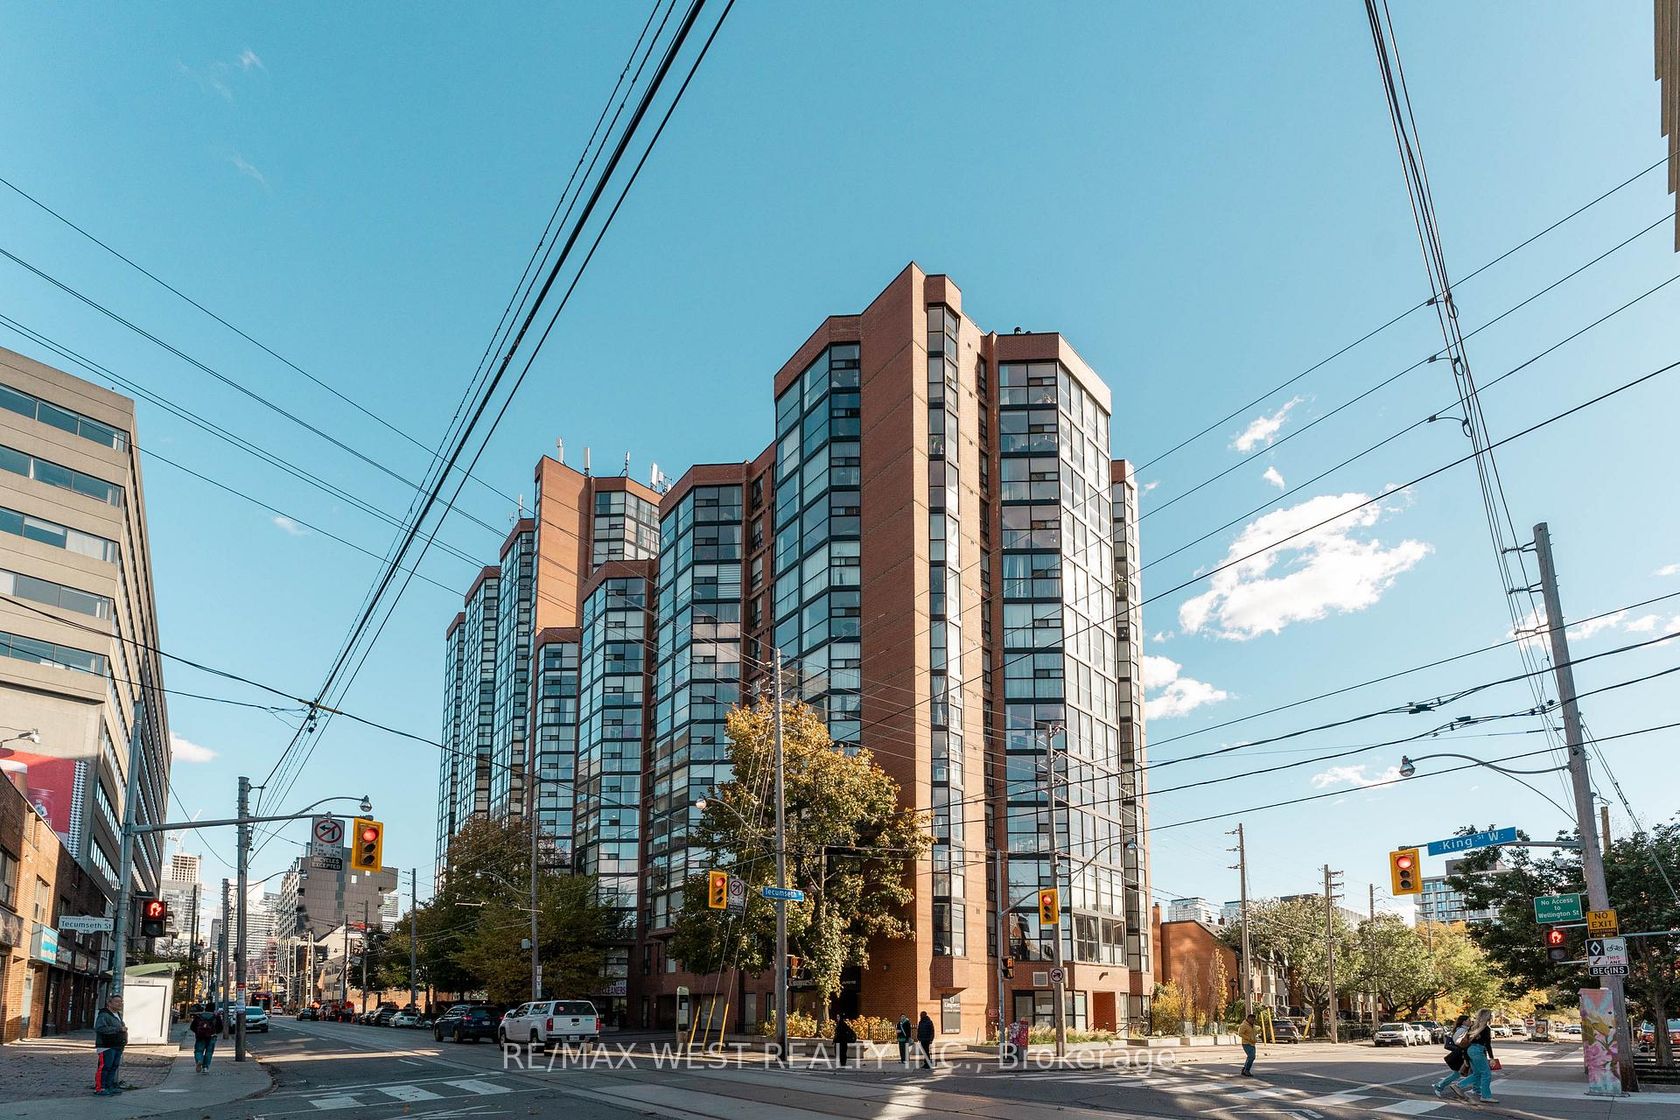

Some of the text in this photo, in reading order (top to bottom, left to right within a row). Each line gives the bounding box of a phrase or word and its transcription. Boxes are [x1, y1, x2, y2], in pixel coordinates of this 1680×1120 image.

[1442, 838, 1473, 850] King
[1488, 831, 1499, 842] W
[1538, 911, 1571, 919] Wellington
[61, 920, 102, 929] Tecumseth
[1591, 920, 1613, 928] EXIT
[1592, 966, 1626, 975] BEGINS
